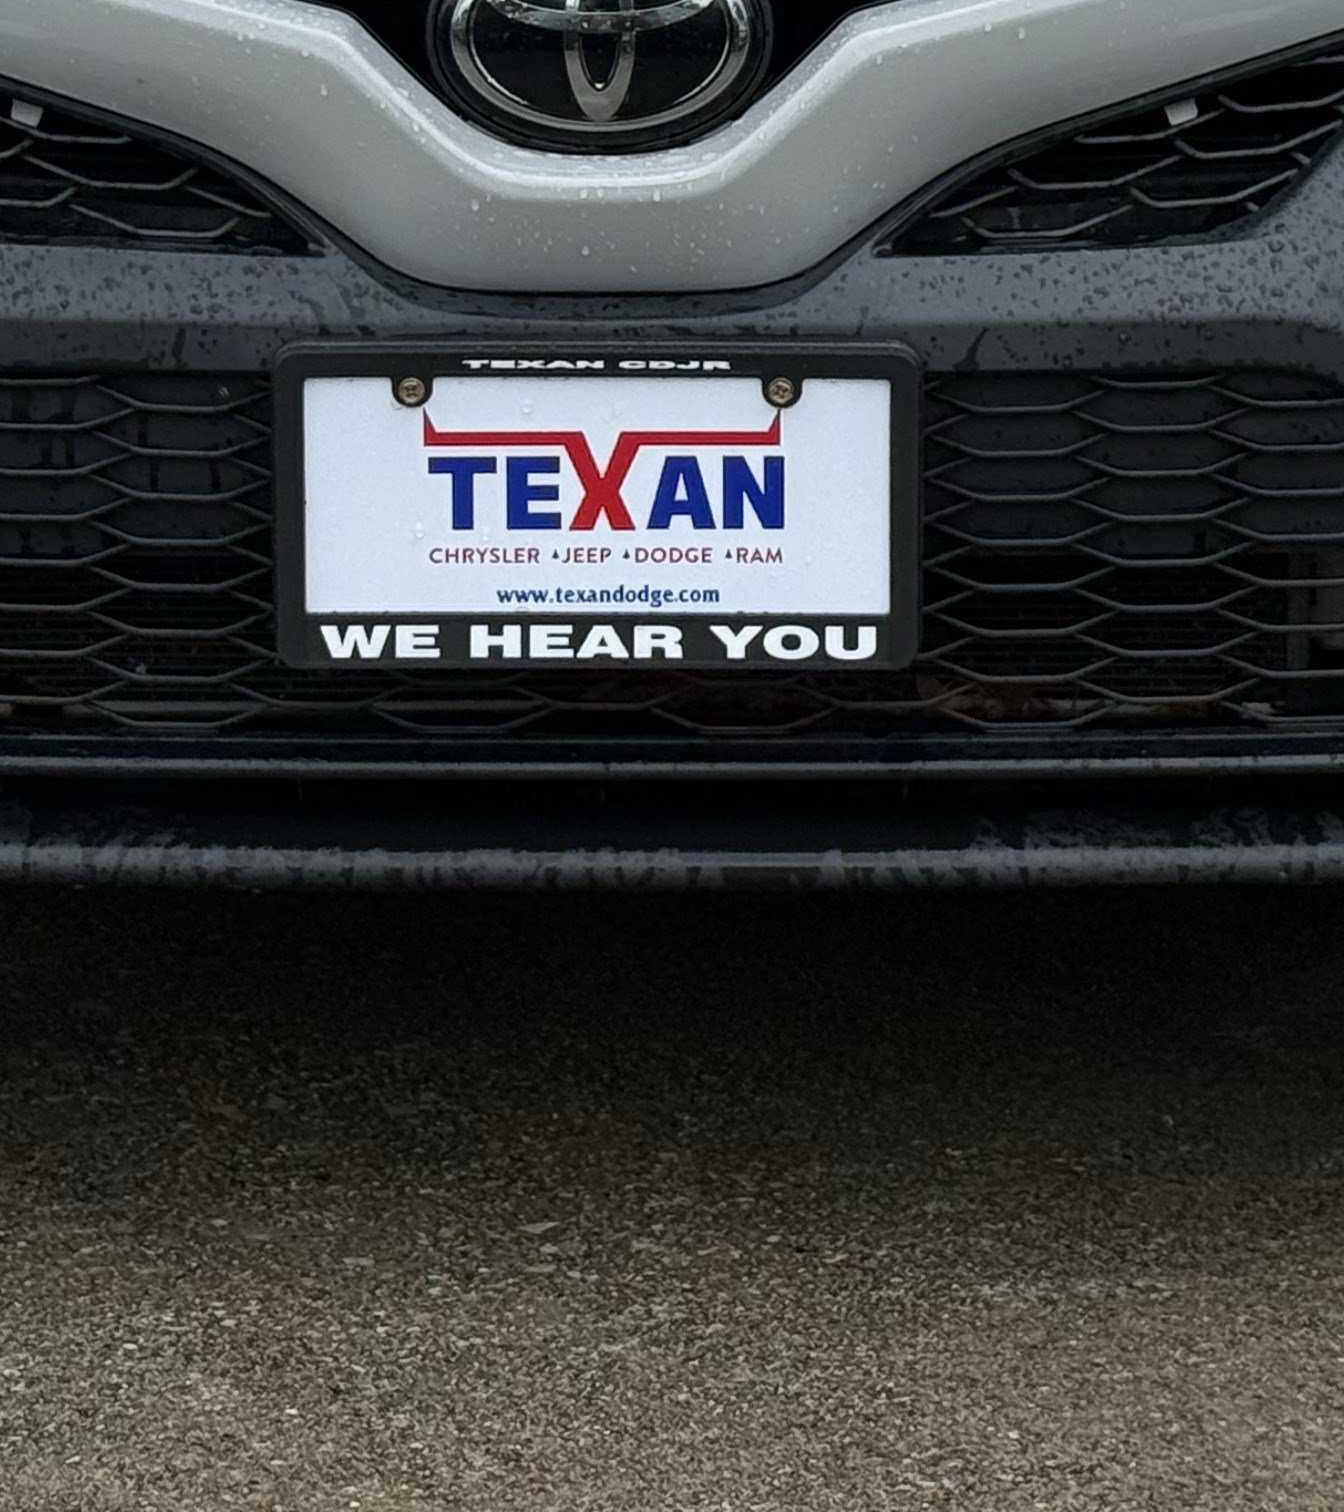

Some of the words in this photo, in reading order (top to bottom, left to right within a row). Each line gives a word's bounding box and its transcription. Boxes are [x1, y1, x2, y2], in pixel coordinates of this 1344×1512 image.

[462, 359, 605, 370] TEXAN
[618, 359, 732, 371] CDJR
[427, 431, 786, 531] TEXAN
[428, 546, 540, 565] CHRYSLER
[561, 546, 613, 565] JEEP
[634, 546, 714, 565] DODGE
[735, 546, 784, 565] RAM
[496, 583, 721, 607] www.texandodge.com
[320, 624, 441, 659] WE
[469, 624, 684, 659] HEAR
[709, 624, 878, 661] YOU
